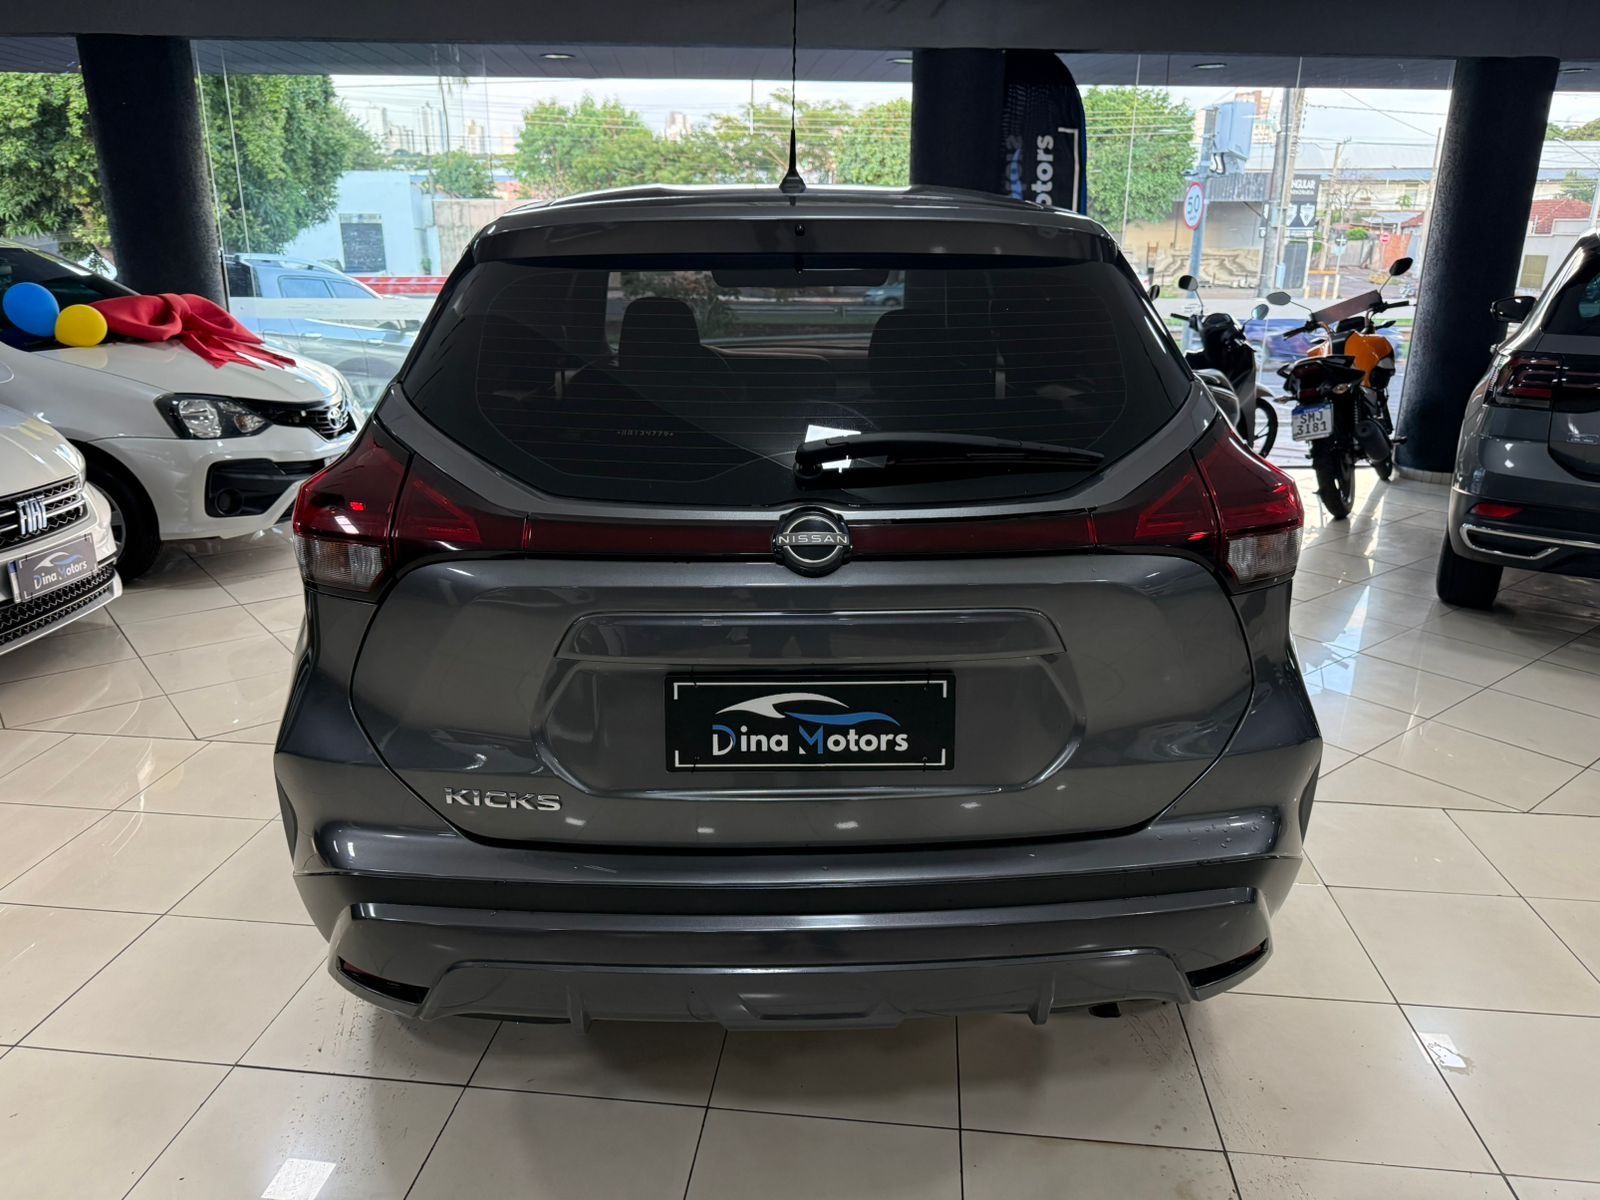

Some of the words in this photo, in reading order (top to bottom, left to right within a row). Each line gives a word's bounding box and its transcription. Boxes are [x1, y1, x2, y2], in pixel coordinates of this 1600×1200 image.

[1187, 194, 1201, 214] 50
[1296, 421, 1327, 435] 3181
[1300, 411, 1324, 424] SMJ
[17, 496, 47, 535] FIAT
[778, 534, 848, 544] NISSAN
[33, 572, 57, 590] Dina
[57, 560, 88, 580] Motors
[712, 724, 789, 756] Dina
[799, 724, 909, 755] Motors
[444, 787, 561, 811] KICKS
